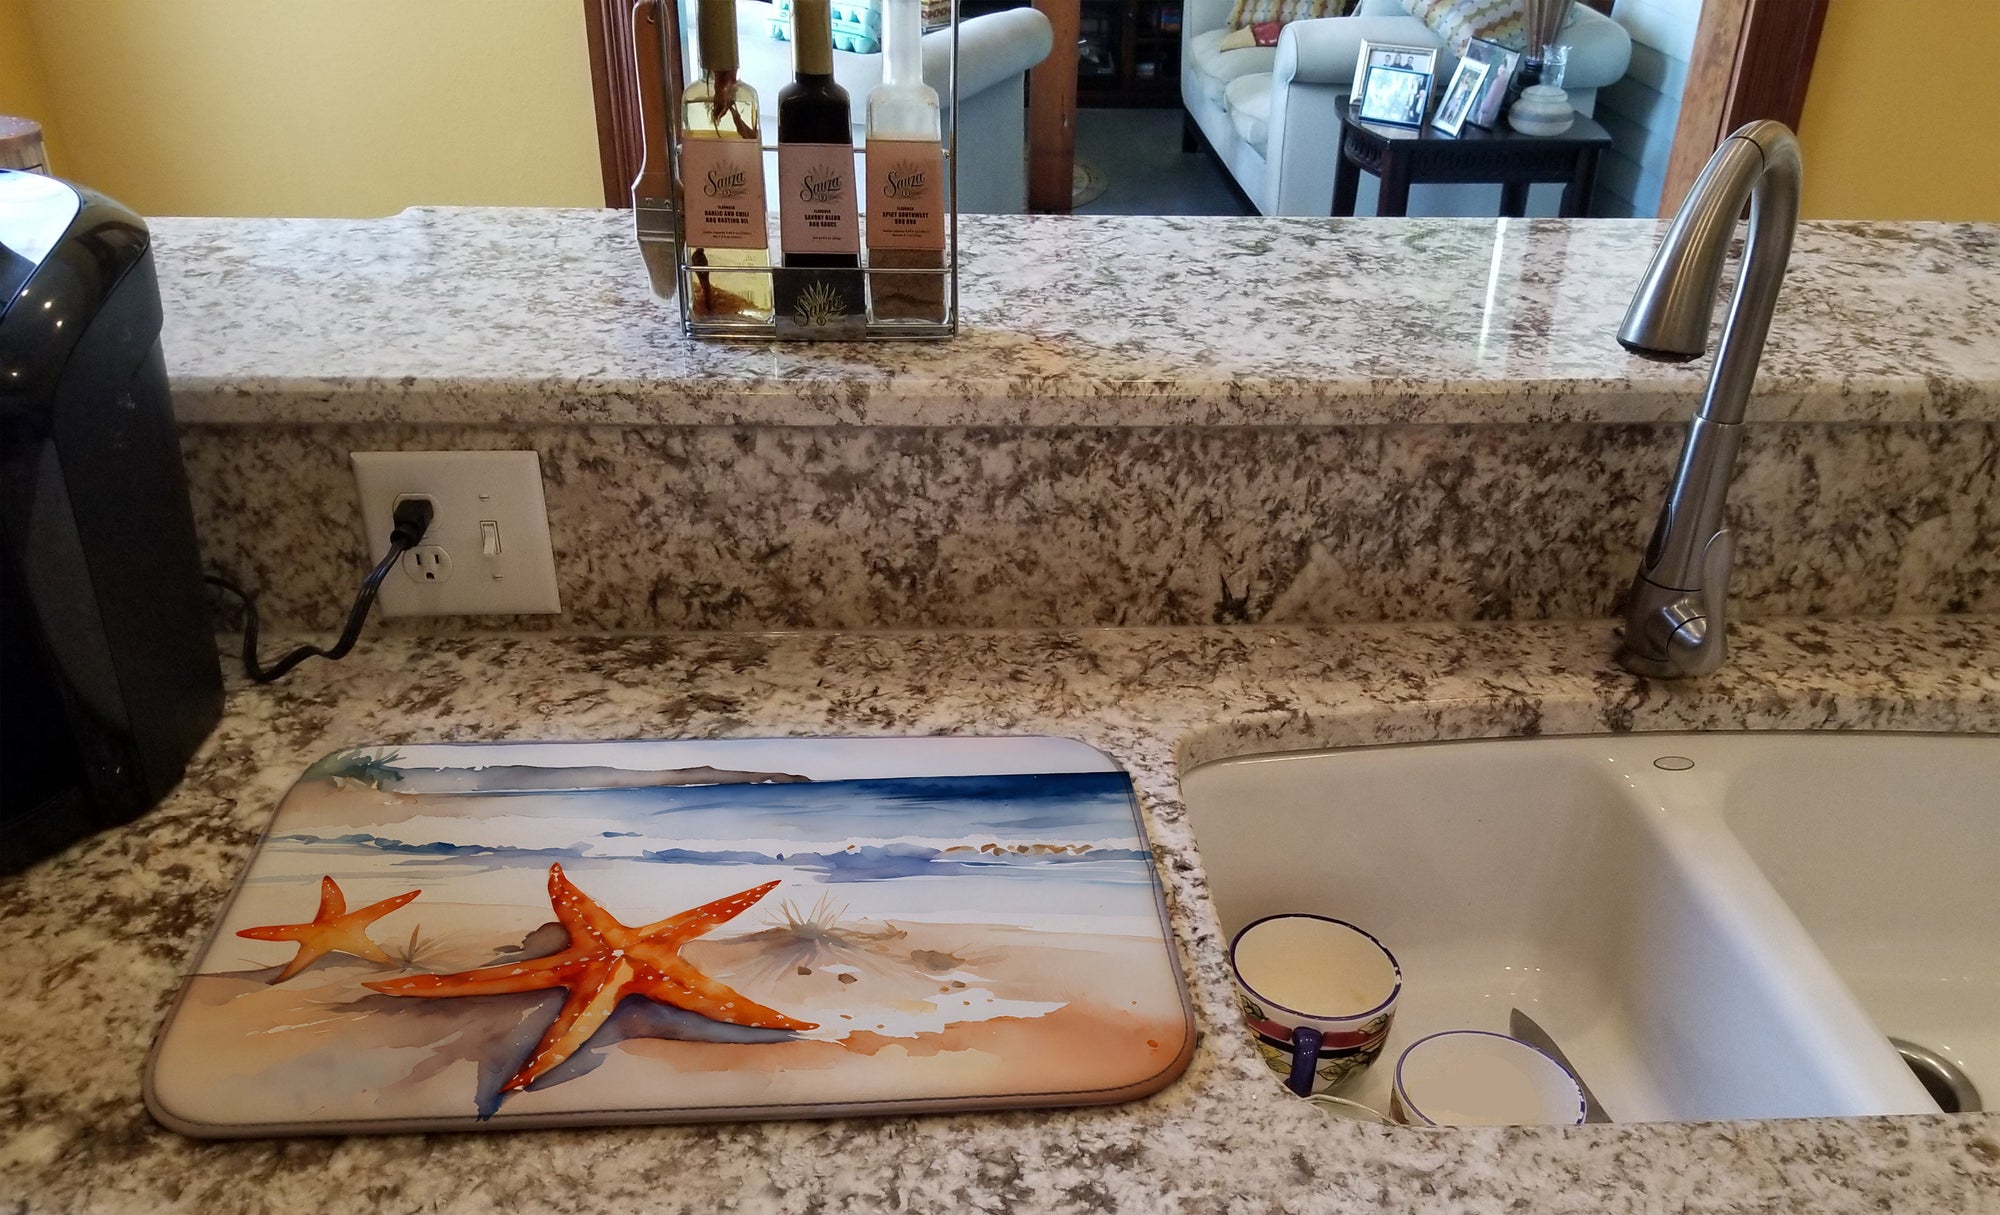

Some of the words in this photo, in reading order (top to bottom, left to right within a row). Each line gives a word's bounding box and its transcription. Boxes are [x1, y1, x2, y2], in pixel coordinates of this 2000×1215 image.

[704, 170, 745, 197] Sauza
[800, 175, 841, 202] Sauza
[884, 171, 925, 198] Sauza
